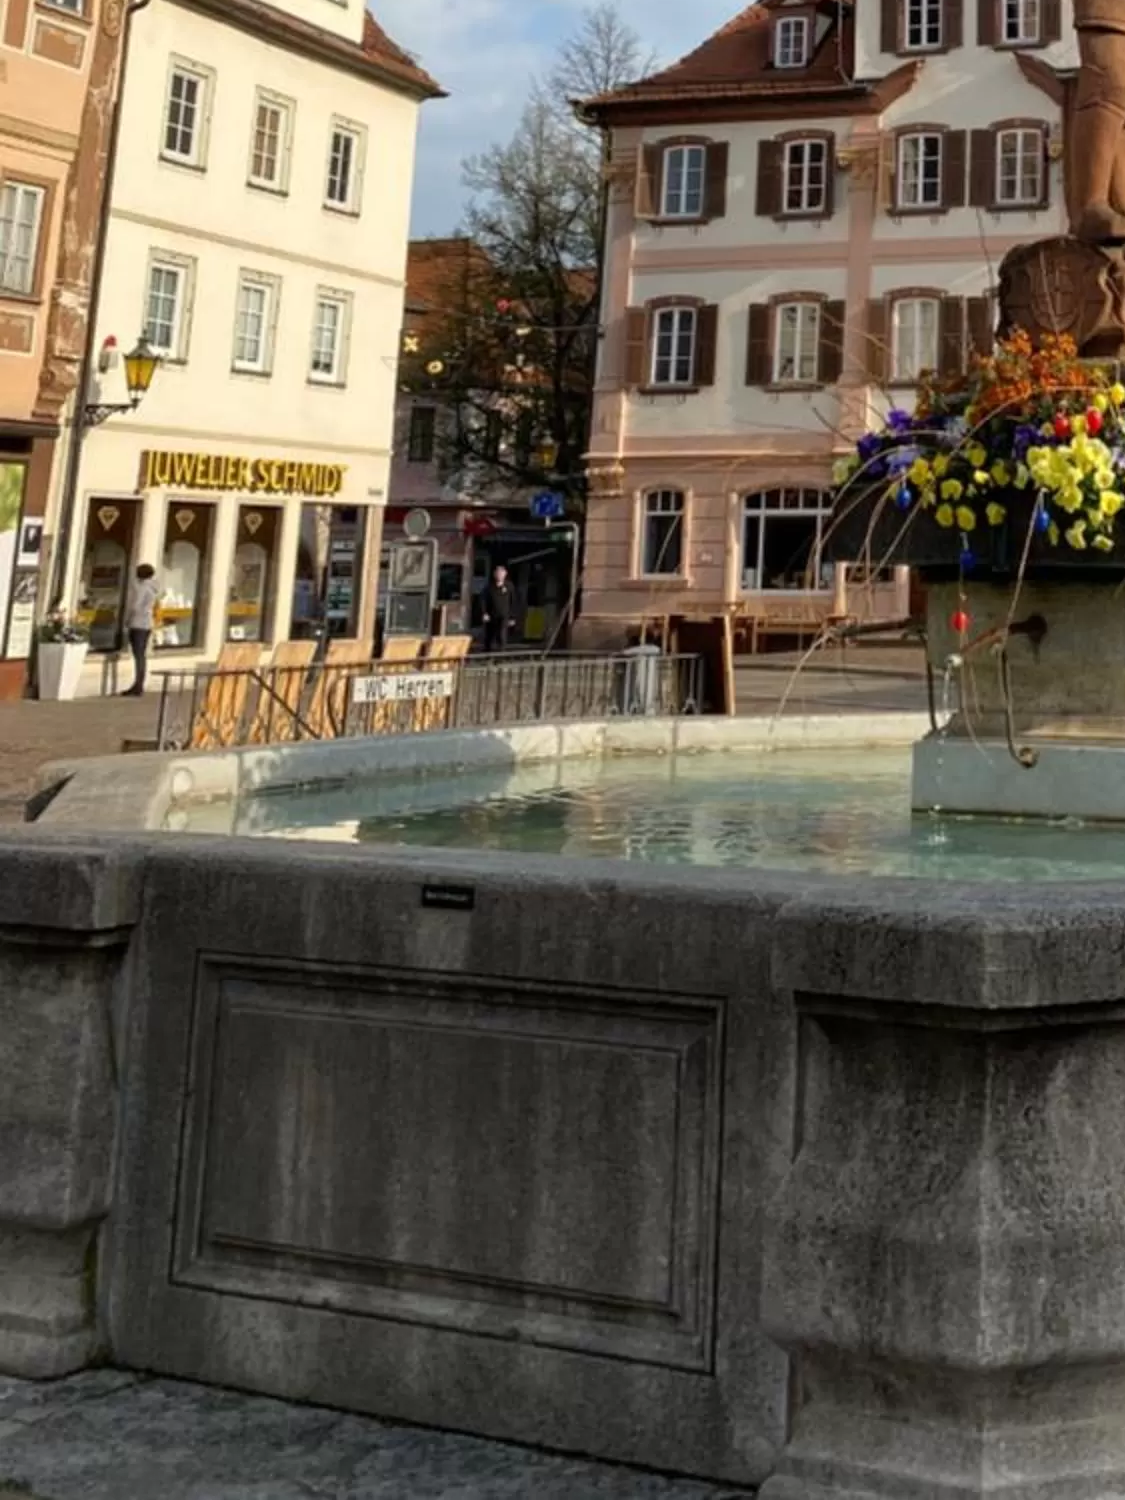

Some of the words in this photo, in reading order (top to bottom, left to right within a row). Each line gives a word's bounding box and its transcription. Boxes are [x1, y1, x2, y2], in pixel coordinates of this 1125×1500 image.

[144, 450, 251, 491] JUWELIER
[250, 458, 349, 496] SCHMIDT
[396, 677, 444, 698] Herren
